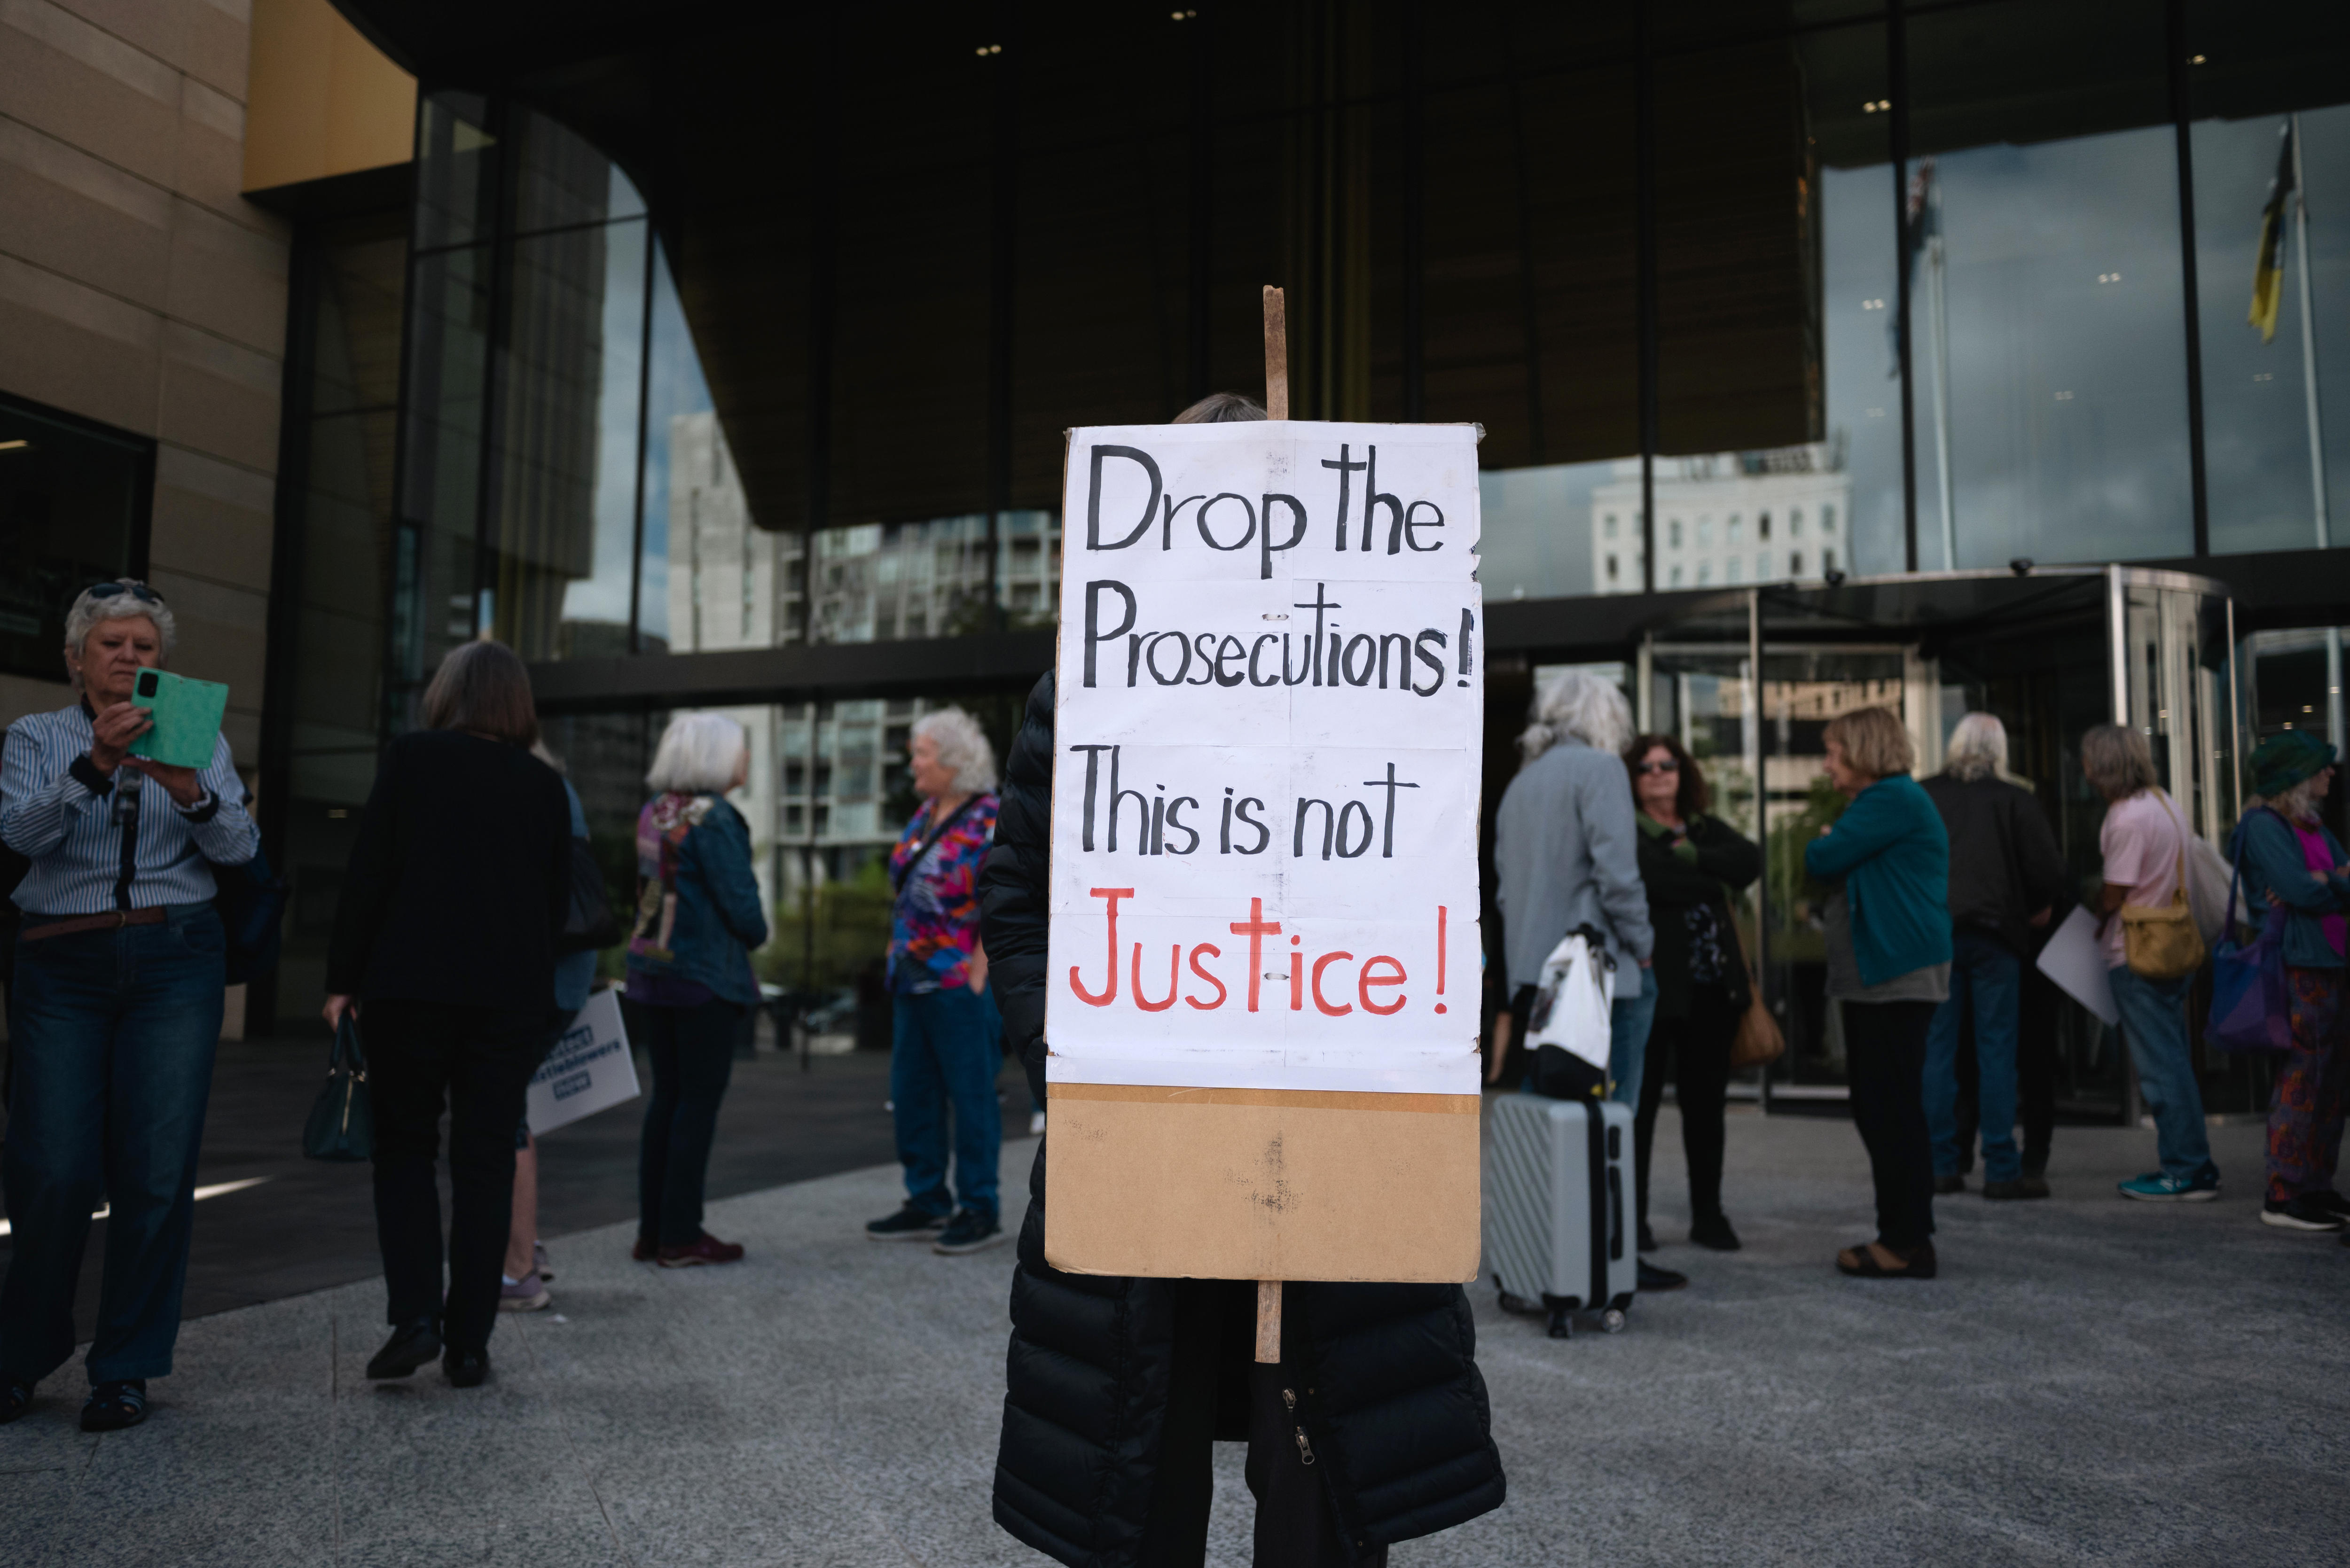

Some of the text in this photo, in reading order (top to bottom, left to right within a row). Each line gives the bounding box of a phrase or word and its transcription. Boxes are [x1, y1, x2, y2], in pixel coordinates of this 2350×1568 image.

[1086, 444, 1445, 580] Drop the
[1083, 580, 1471, 697] Prosecutions!
[1070, 745, 1420, 859] This is not
